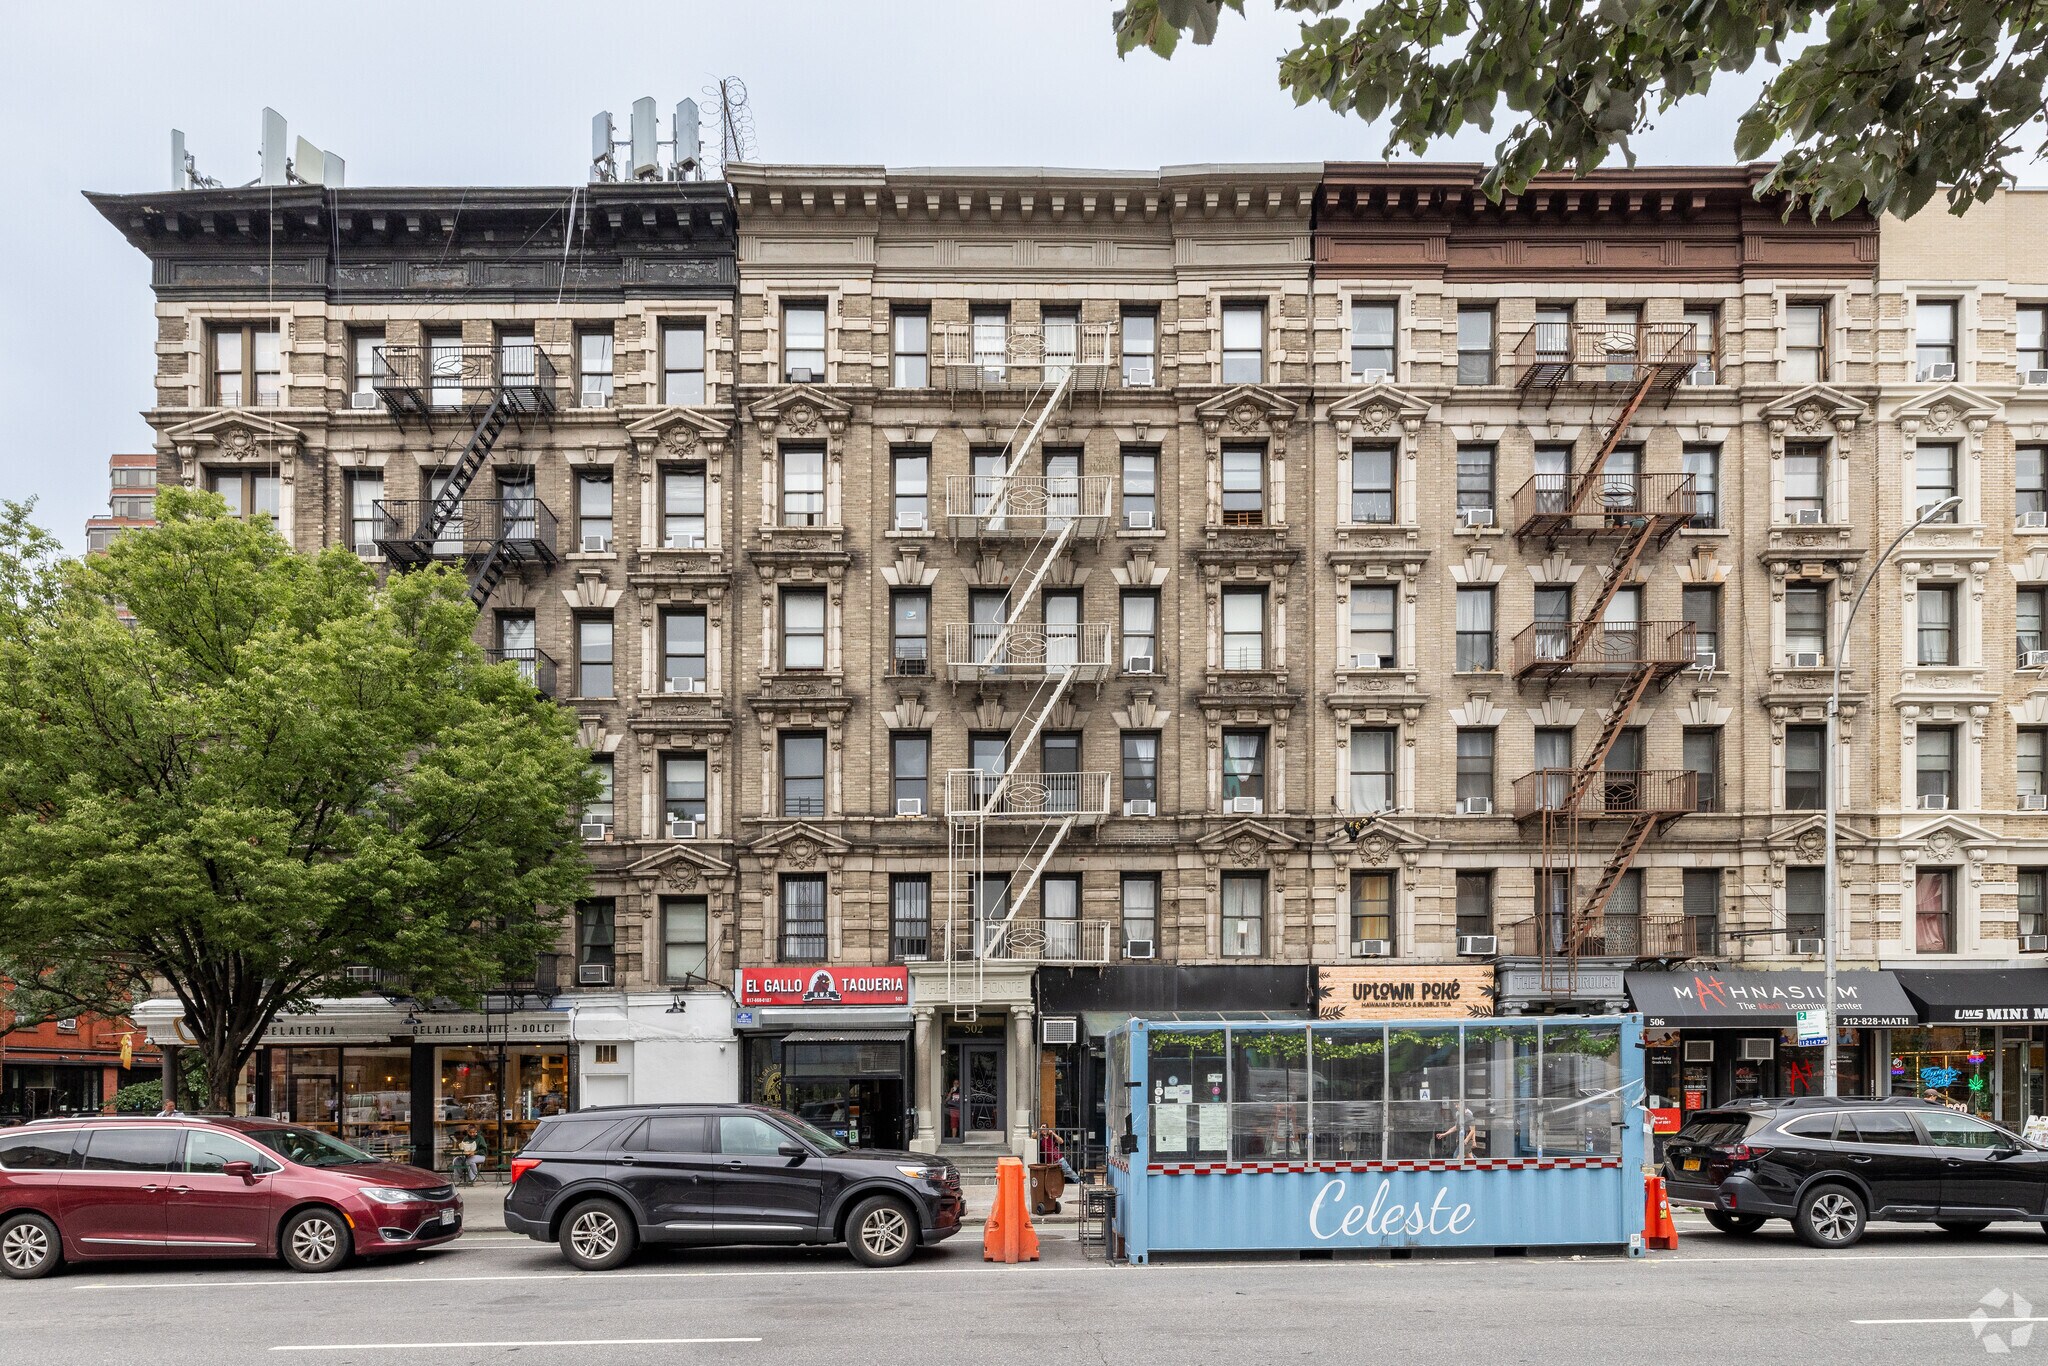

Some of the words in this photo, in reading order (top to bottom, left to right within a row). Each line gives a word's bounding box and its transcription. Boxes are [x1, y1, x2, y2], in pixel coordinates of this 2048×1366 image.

[746, 979, 760, 993] EL
[764, 978, 803, 993] GALLO
[841, 977, 904, 992] TAQUERIA
[1736, 1002, 1756, 1010] The
[1836, 1002, 1863, 1010] enter
[1954, 1009, 1984, 1020] UWS
[1986, 1008, 2029, 1020] MINI
[1649, 1018, 1665, 1026] 506
[1842, 1017, 1909, 1025] 212-828-MATH
[263, 1026, 336, 1036] GELATERIA
[412, 1025, 451, 1035] GELATI
[462, 1024, 510, 1034] GRANITE
[521, 1023, 556, 1033] DOLCI
[964, 1023, 984, 1034] 502
[1309, 1178, 1476, 1240] Celeste
